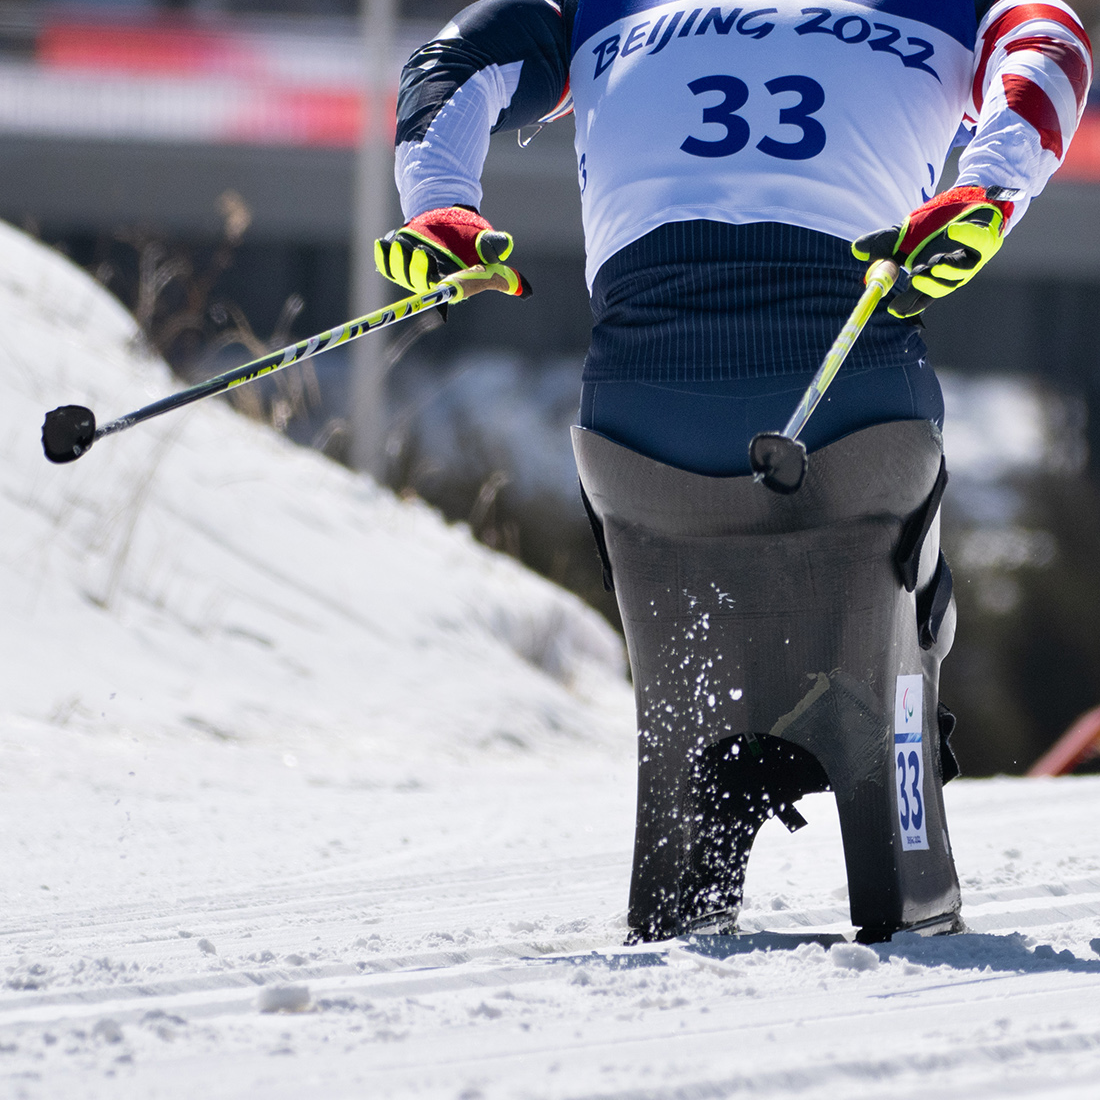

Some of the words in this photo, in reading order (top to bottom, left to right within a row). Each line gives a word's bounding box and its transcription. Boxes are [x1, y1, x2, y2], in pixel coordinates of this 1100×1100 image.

[592, 7, 778, 81] BEIJING
[793, 7, 943, 85] 2022
[679, 74, 828, 161] 33
[897, 750, 923, 830] 33
